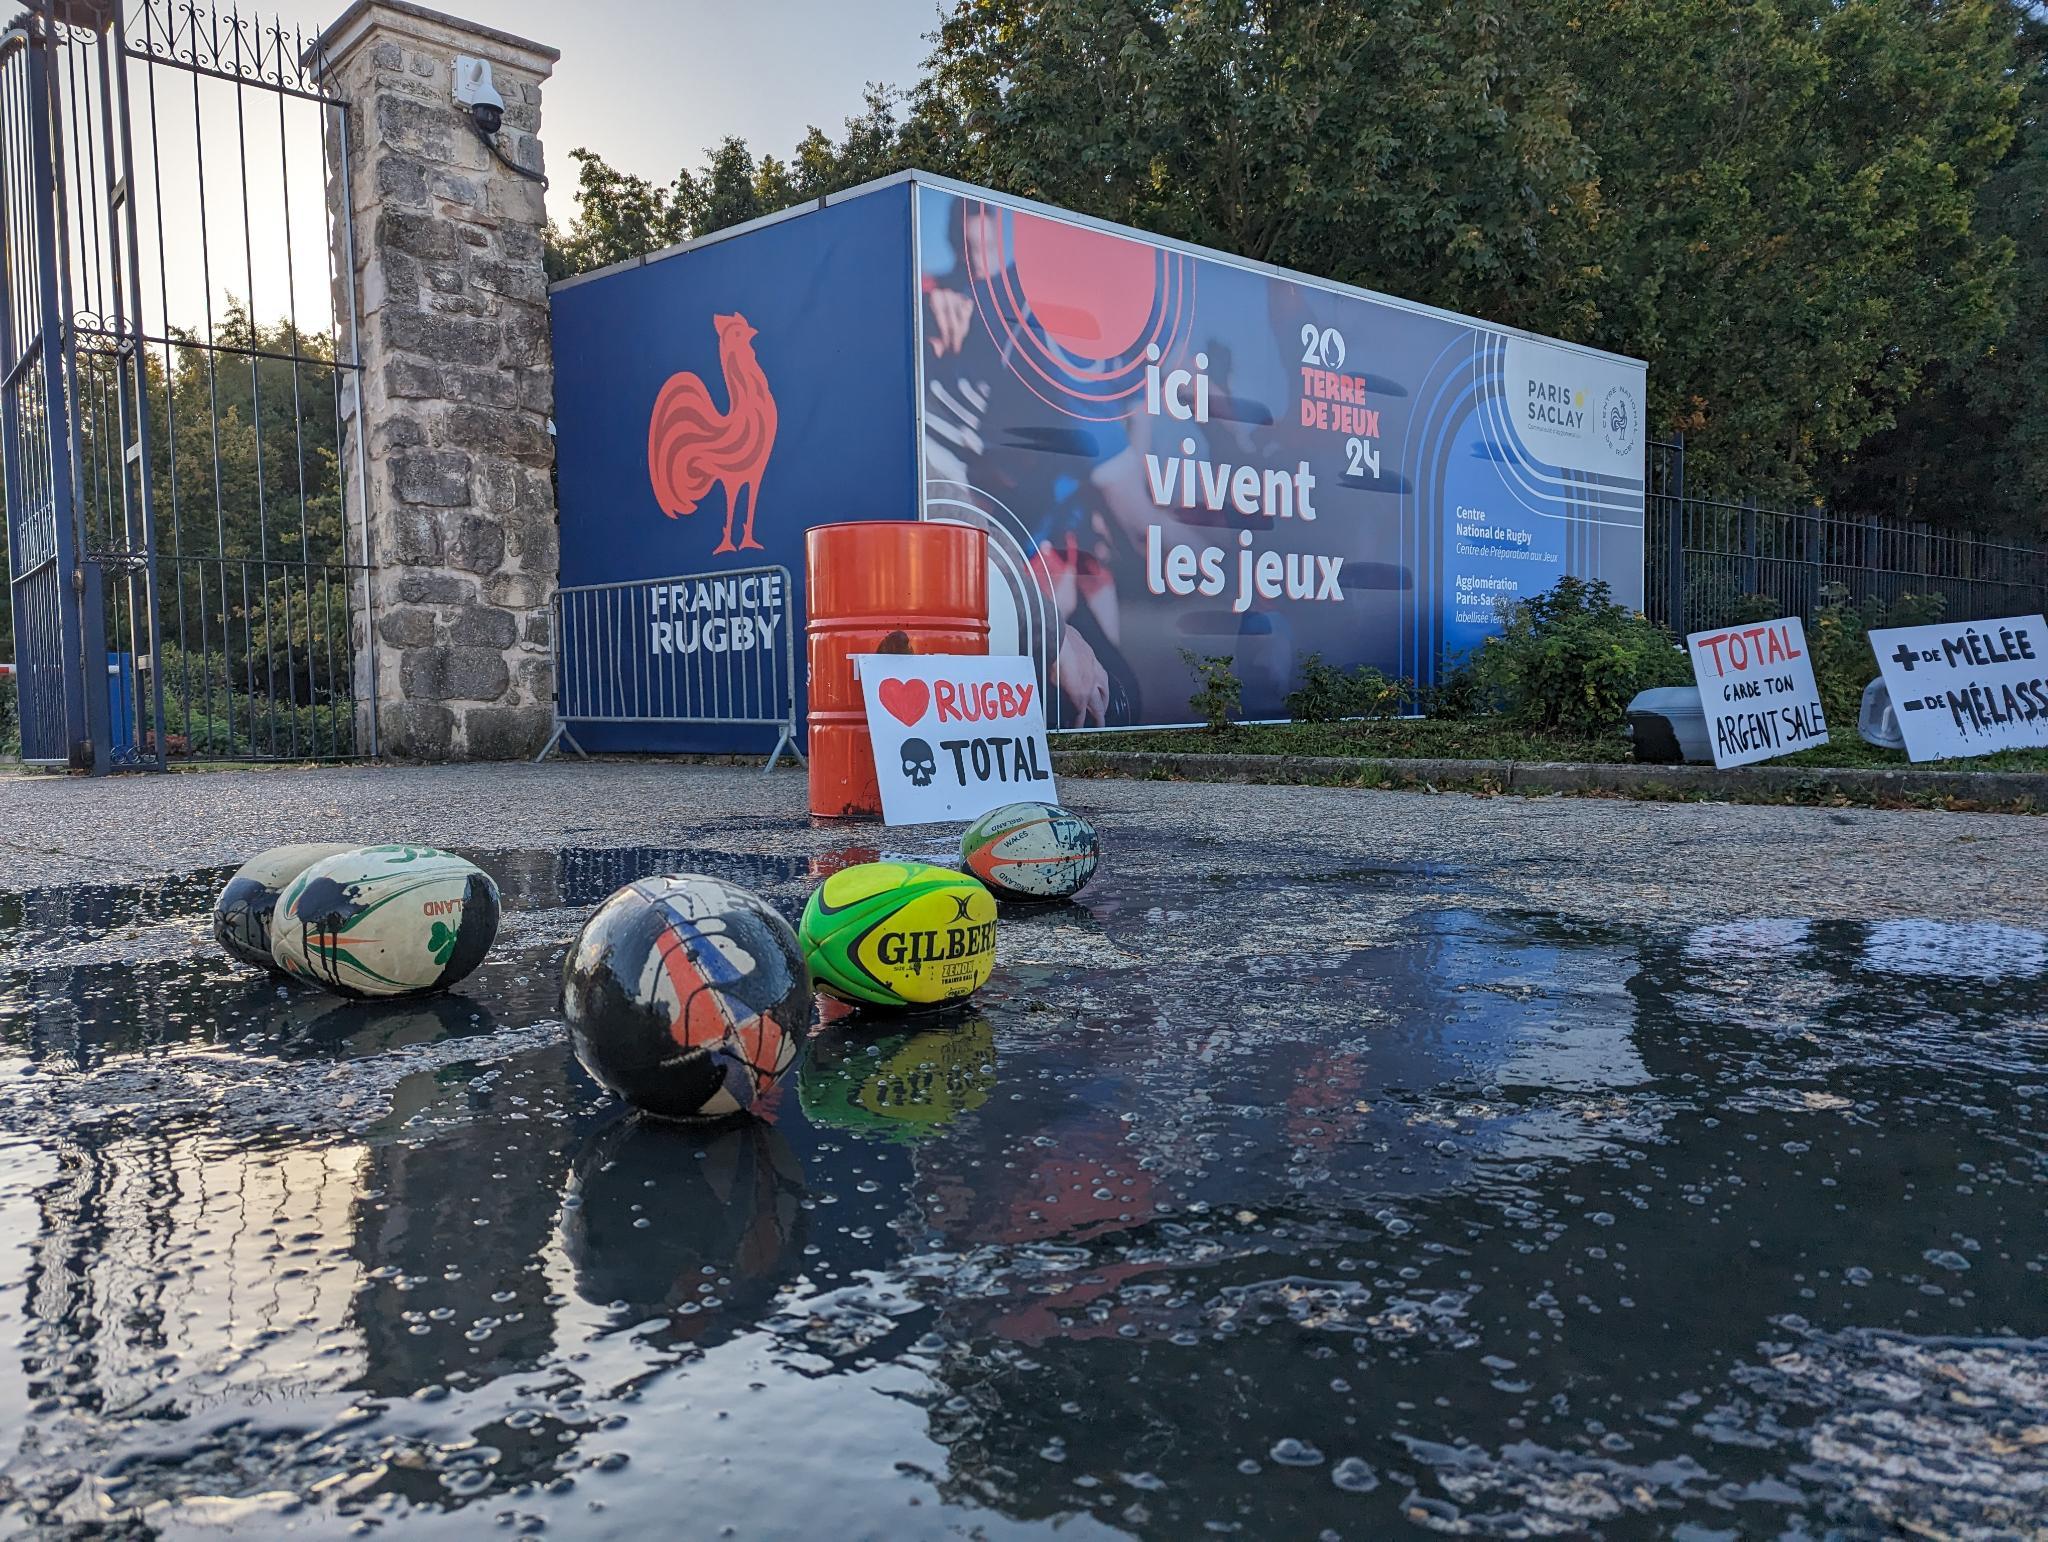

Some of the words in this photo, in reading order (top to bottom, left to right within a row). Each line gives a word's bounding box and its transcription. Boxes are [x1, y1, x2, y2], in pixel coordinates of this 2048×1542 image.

[1301, 323, 1346, 370] 20
[1145, 343, 1209, 423] ici
[1301, 367, 1366, 405] TERRE
[1528, 379, 1571, 406] PARIS
[1301, 399, 1328, 430] DE
[1331, 404, 1380, 438] JEUX
[1528, 402, 1584, 429] SACLAY
[1345, 437, 1380, 479] 24
[1145, 438, 1316, 521] vivent
[1456, 506, 1486, 521] Centre
[1456, 523, 1493, 539] National
[1494, 527, 1505, 541] de
[1506, 529, 1532, 546] Rugby
[1456, 542, 1480, 555] Centre
[1480, 545, 1490, 556] de
[1490, 546, 1530, 561] Préparation
[1146, 525, 1226, 597] les
[1232, 529, 1345, 613] jeux
[1456, 574, 1518, 591] Agglomération
[651, 576, 782, 615] FRANCE
[651, 614, 782, 655] RUGBY
[1698, 625, 1801, 677] TOTAL
[1922, 649, 1942, 662] DE
[1941, 626, 2036, 668] MÊLÉE
[934, 680, 1033, 723] RUGBY
[1724, 680, 1761, 701] GARDE
[1764, 674, 1794, 695] TON
[1924, 695, 1946, 709] DE
[1716, 710, 1778, 758] ARGENT
[1782, 702, 1827, 742] SALE
[940, 736, 1049, 787] TOTAL
[991, 816, 1024, 832] IRELAND
[1003, 830, 1029, 848] WALES
[877, 919, 998, 965] GILBERT
